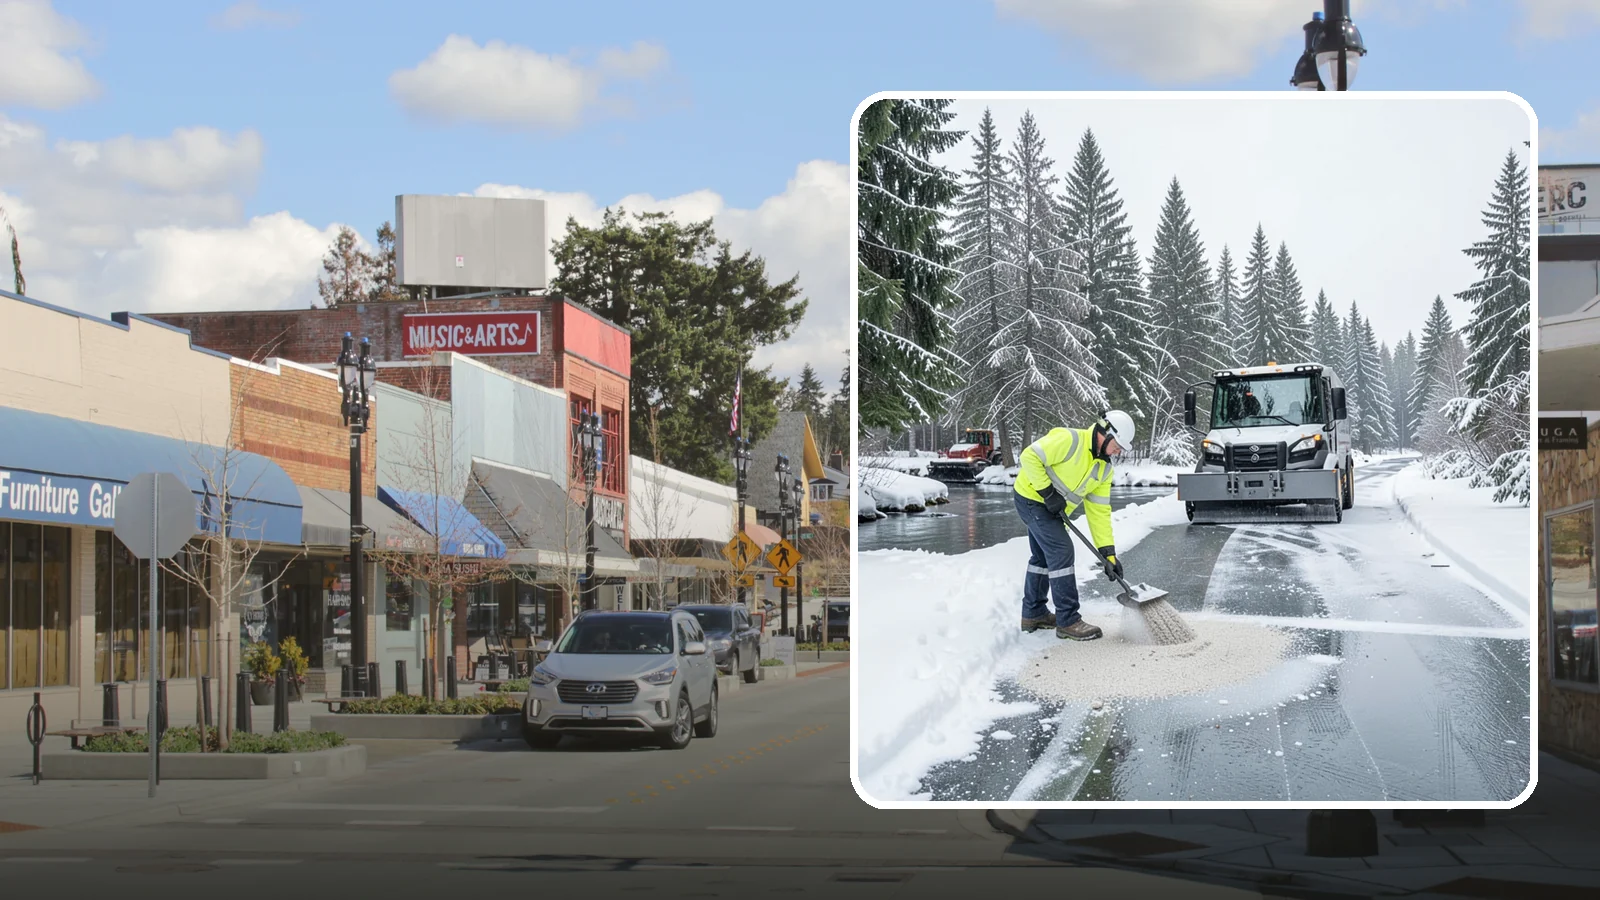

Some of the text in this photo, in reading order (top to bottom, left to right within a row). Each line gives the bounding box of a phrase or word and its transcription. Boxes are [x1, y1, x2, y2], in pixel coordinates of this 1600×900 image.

[409, 323, 519, 349] MUSIC&ARTS
[1540, 427, 1577, 437] UGA
[0, 471, 122, 519] Furniture Gal
[453, 563, 479, 574] SUSHI
